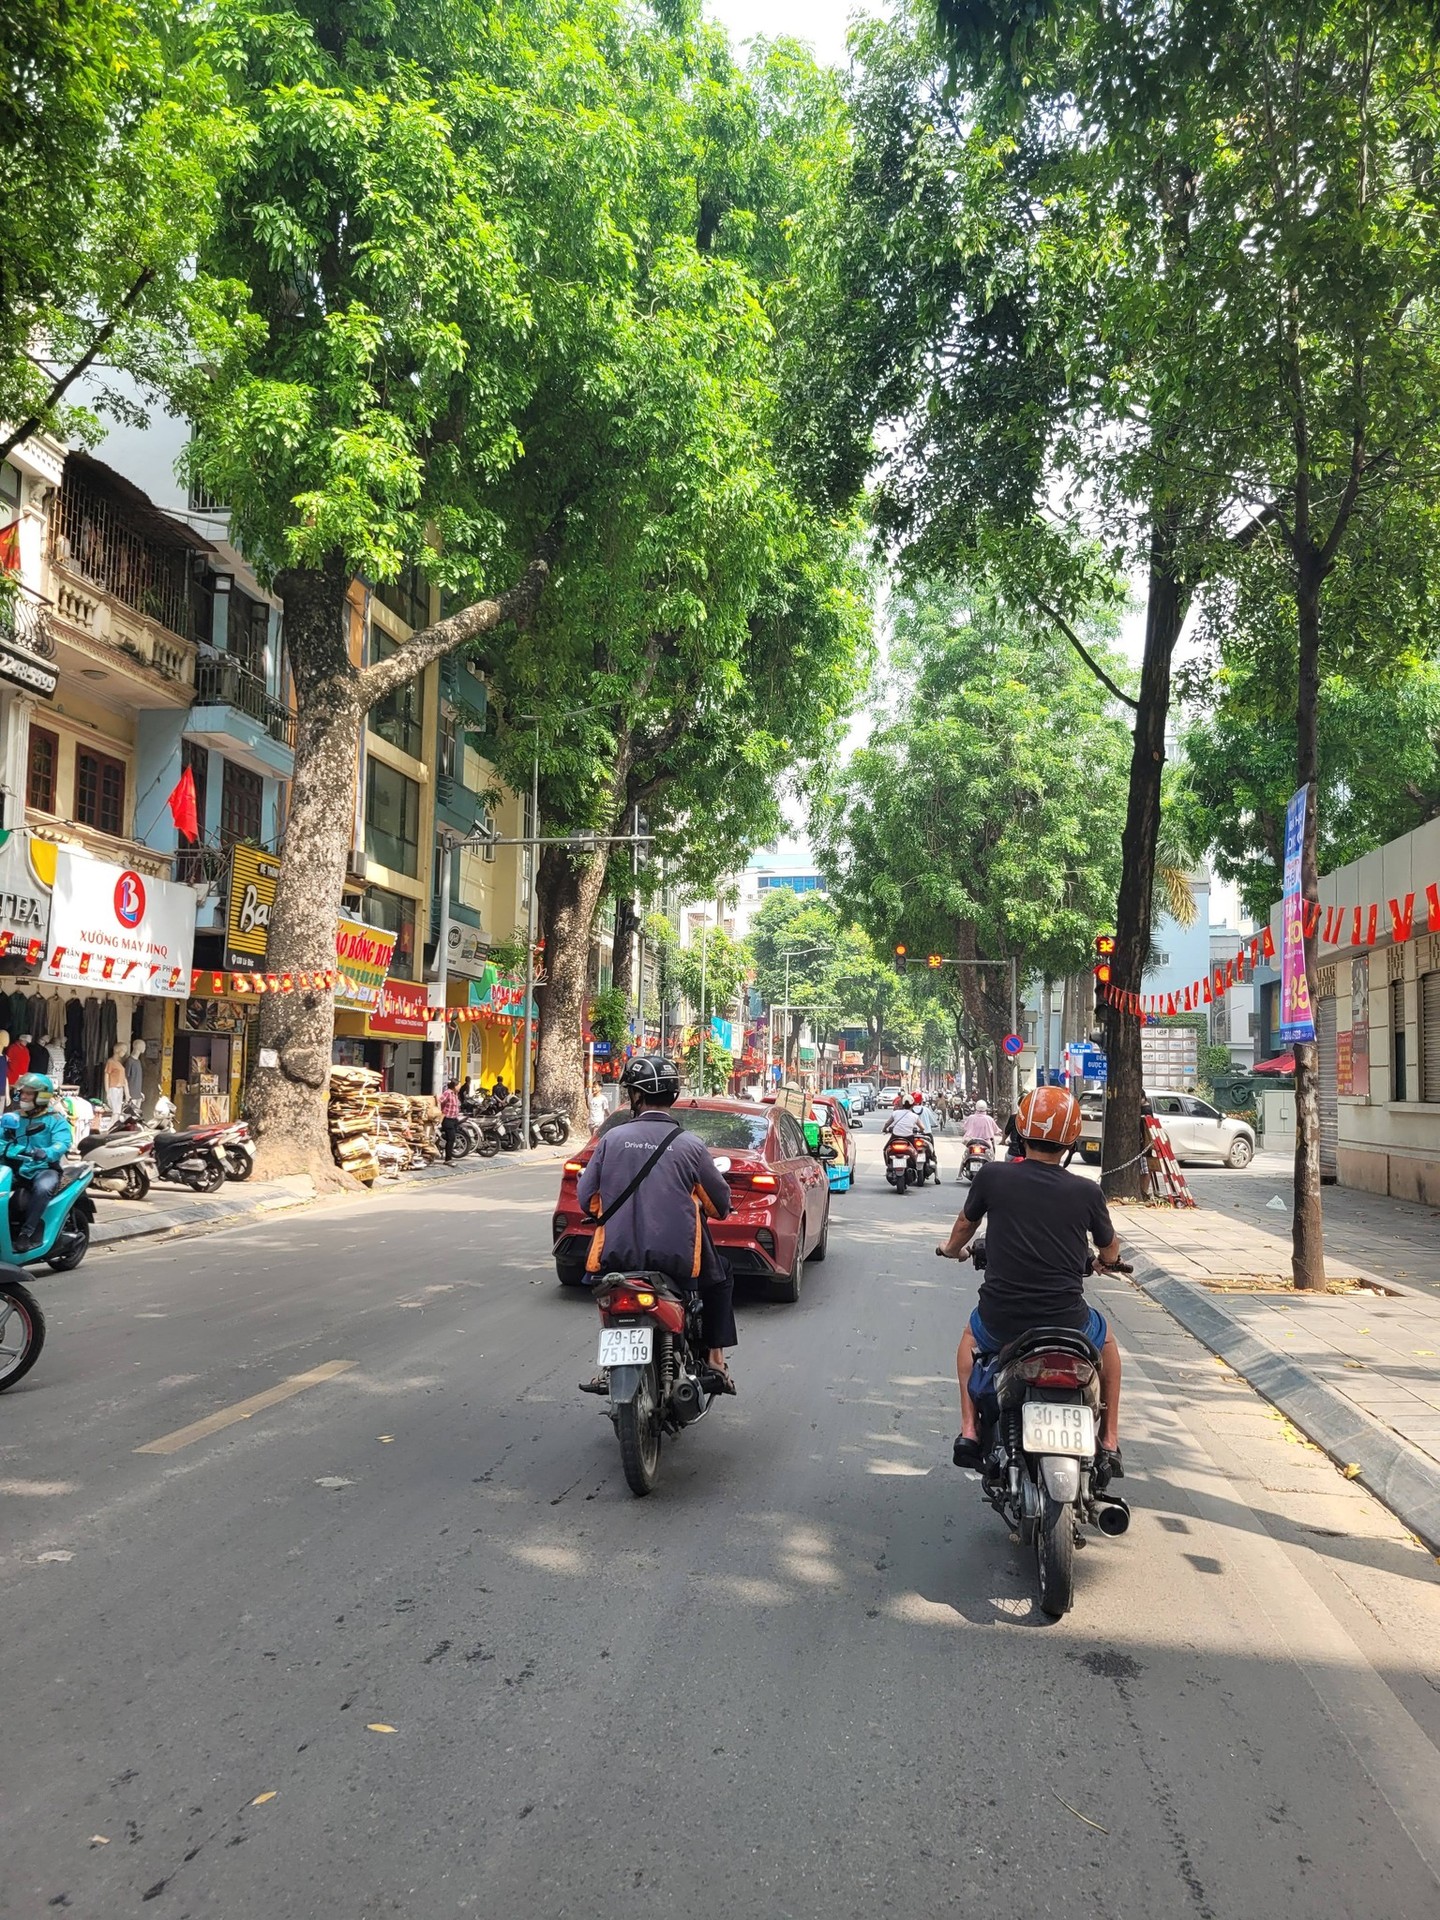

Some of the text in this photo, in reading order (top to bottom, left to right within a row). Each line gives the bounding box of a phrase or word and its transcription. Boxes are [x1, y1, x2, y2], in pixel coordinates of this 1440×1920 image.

[240, 885, 272, 933] Ba
[80, 930, 168, 959] XƯỞNG MAY JINQ
[1100, 940, 1114, 952] 32
[929, 956, 941, 966] 32
[624, 1141, 643, 1149] Drive
[607, 1330, 645, 1346] 29-E2
[602, 1346, 648, 1363] 751.09
